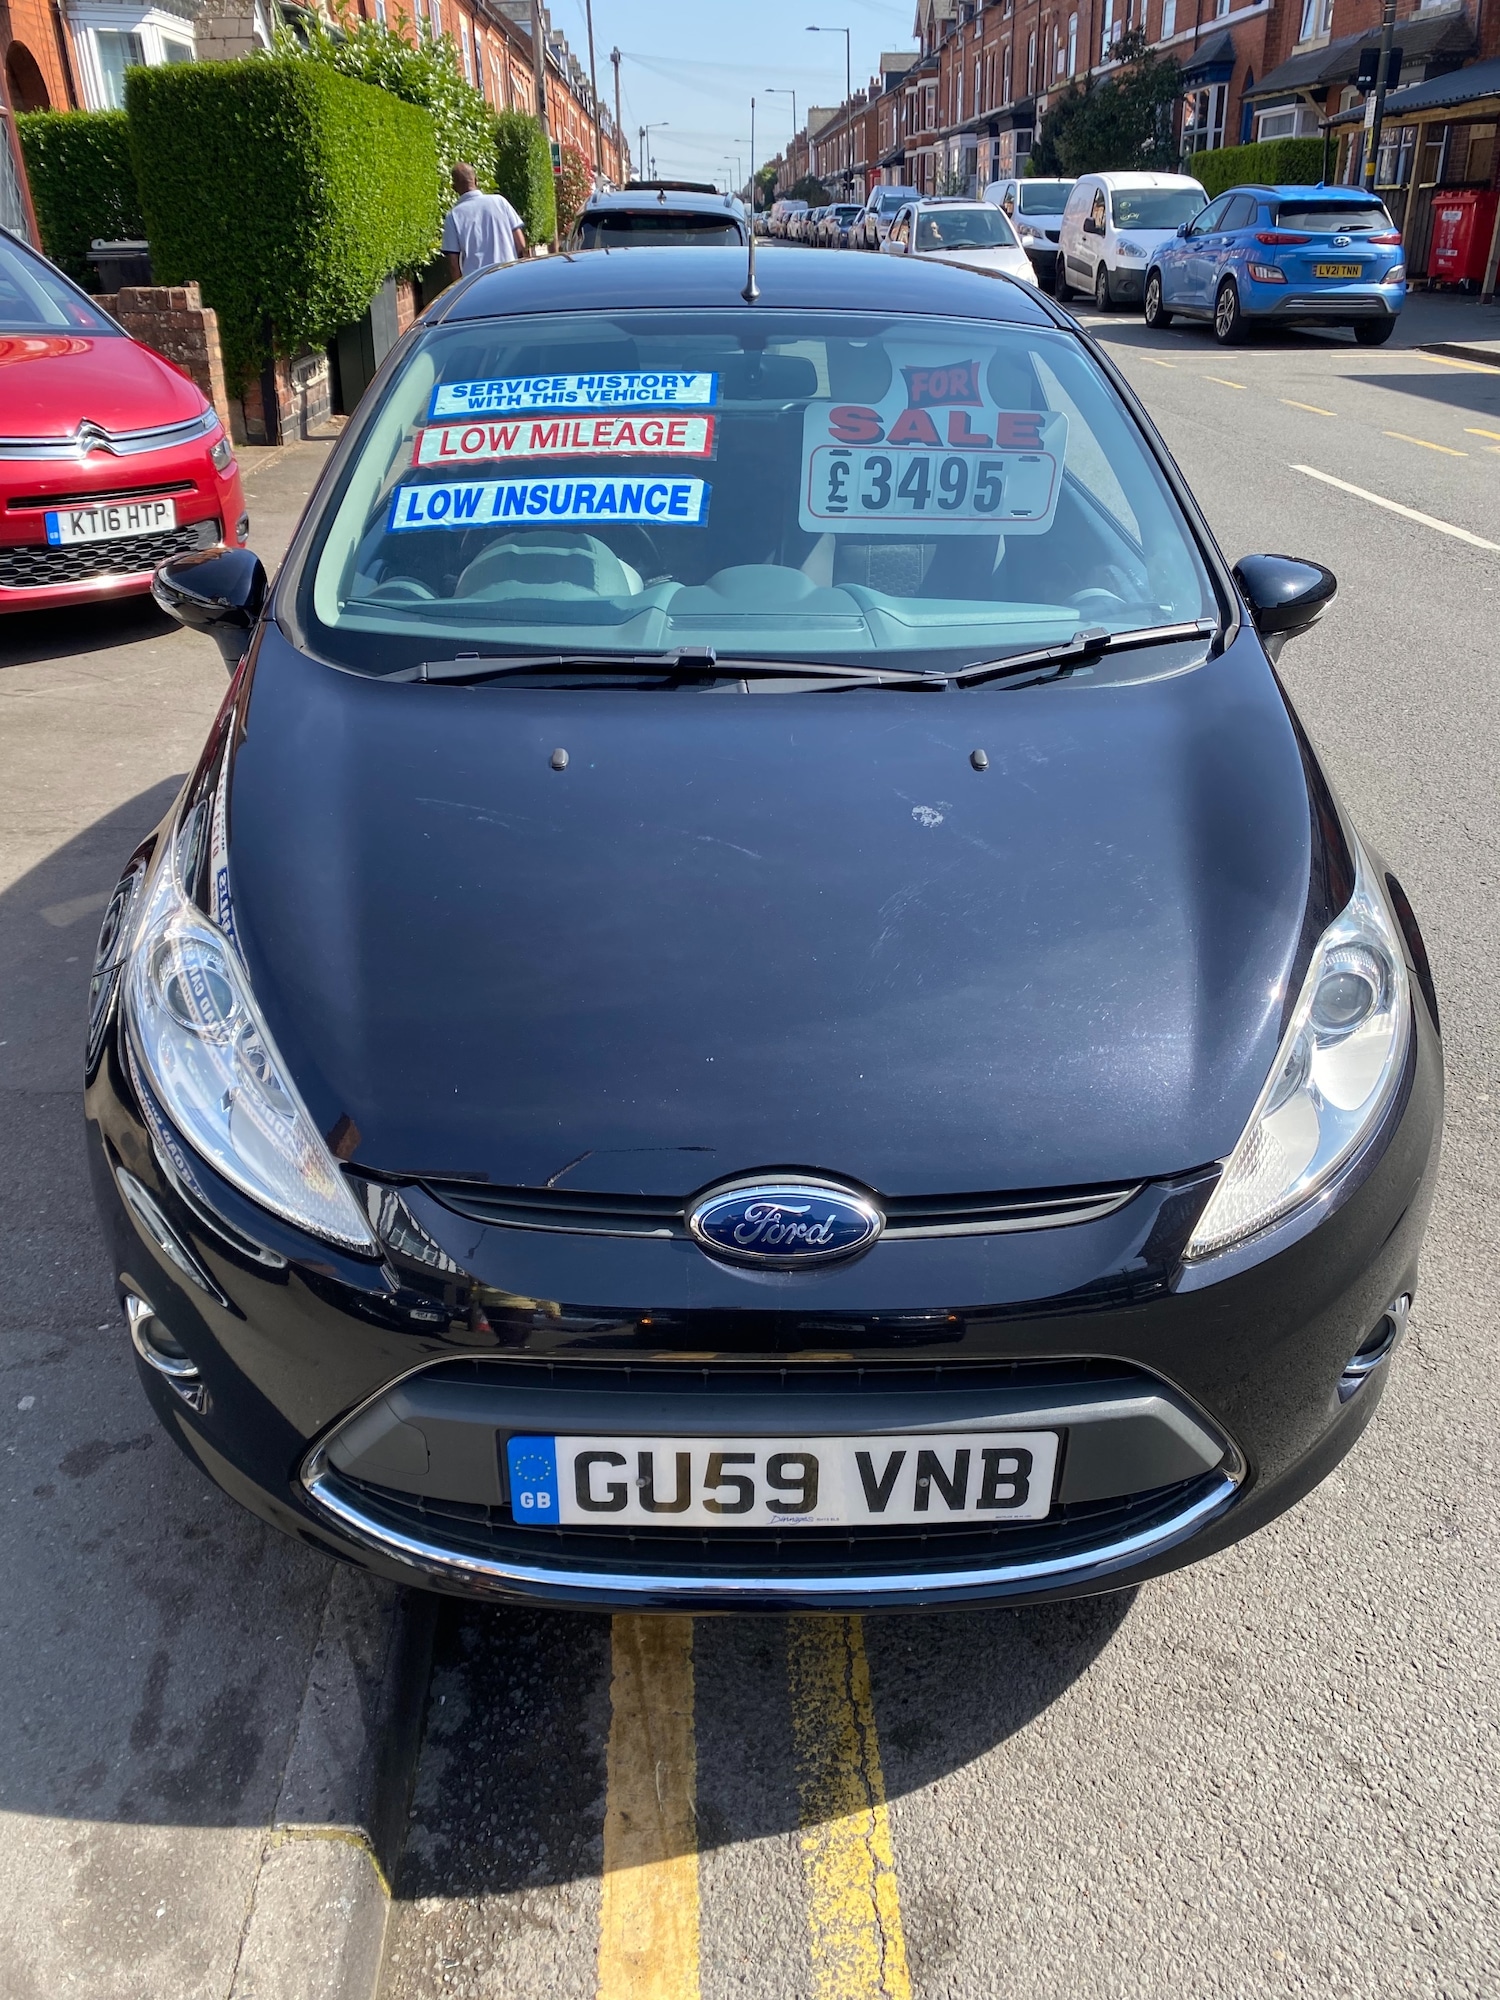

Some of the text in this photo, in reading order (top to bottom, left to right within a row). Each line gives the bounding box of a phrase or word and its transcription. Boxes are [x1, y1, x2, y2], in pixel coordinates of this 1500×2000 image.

[1319, 265, 1359, 275] LV21 TNN
[451, 374, 698, 398] SERVICE HISTORY
[467, 388, 678, 409] WITH THIS VEHICLE
[911, 370, 970, 401] FOR
[439, 420, 690, 456] LOW MILEAGE
[828, 405, 1046, 450] SALE
[827, 455, 1004, 513] £3495
[69, 502, 166, 536] KT16 HTP
[405, 483, 692, 522] LOW INSURANCE
[733, 1202, 837, 1245] Ford
[573, 1448, 1035, 1515] GU59 VNB
[519, 1491, 552, 1510] GB
